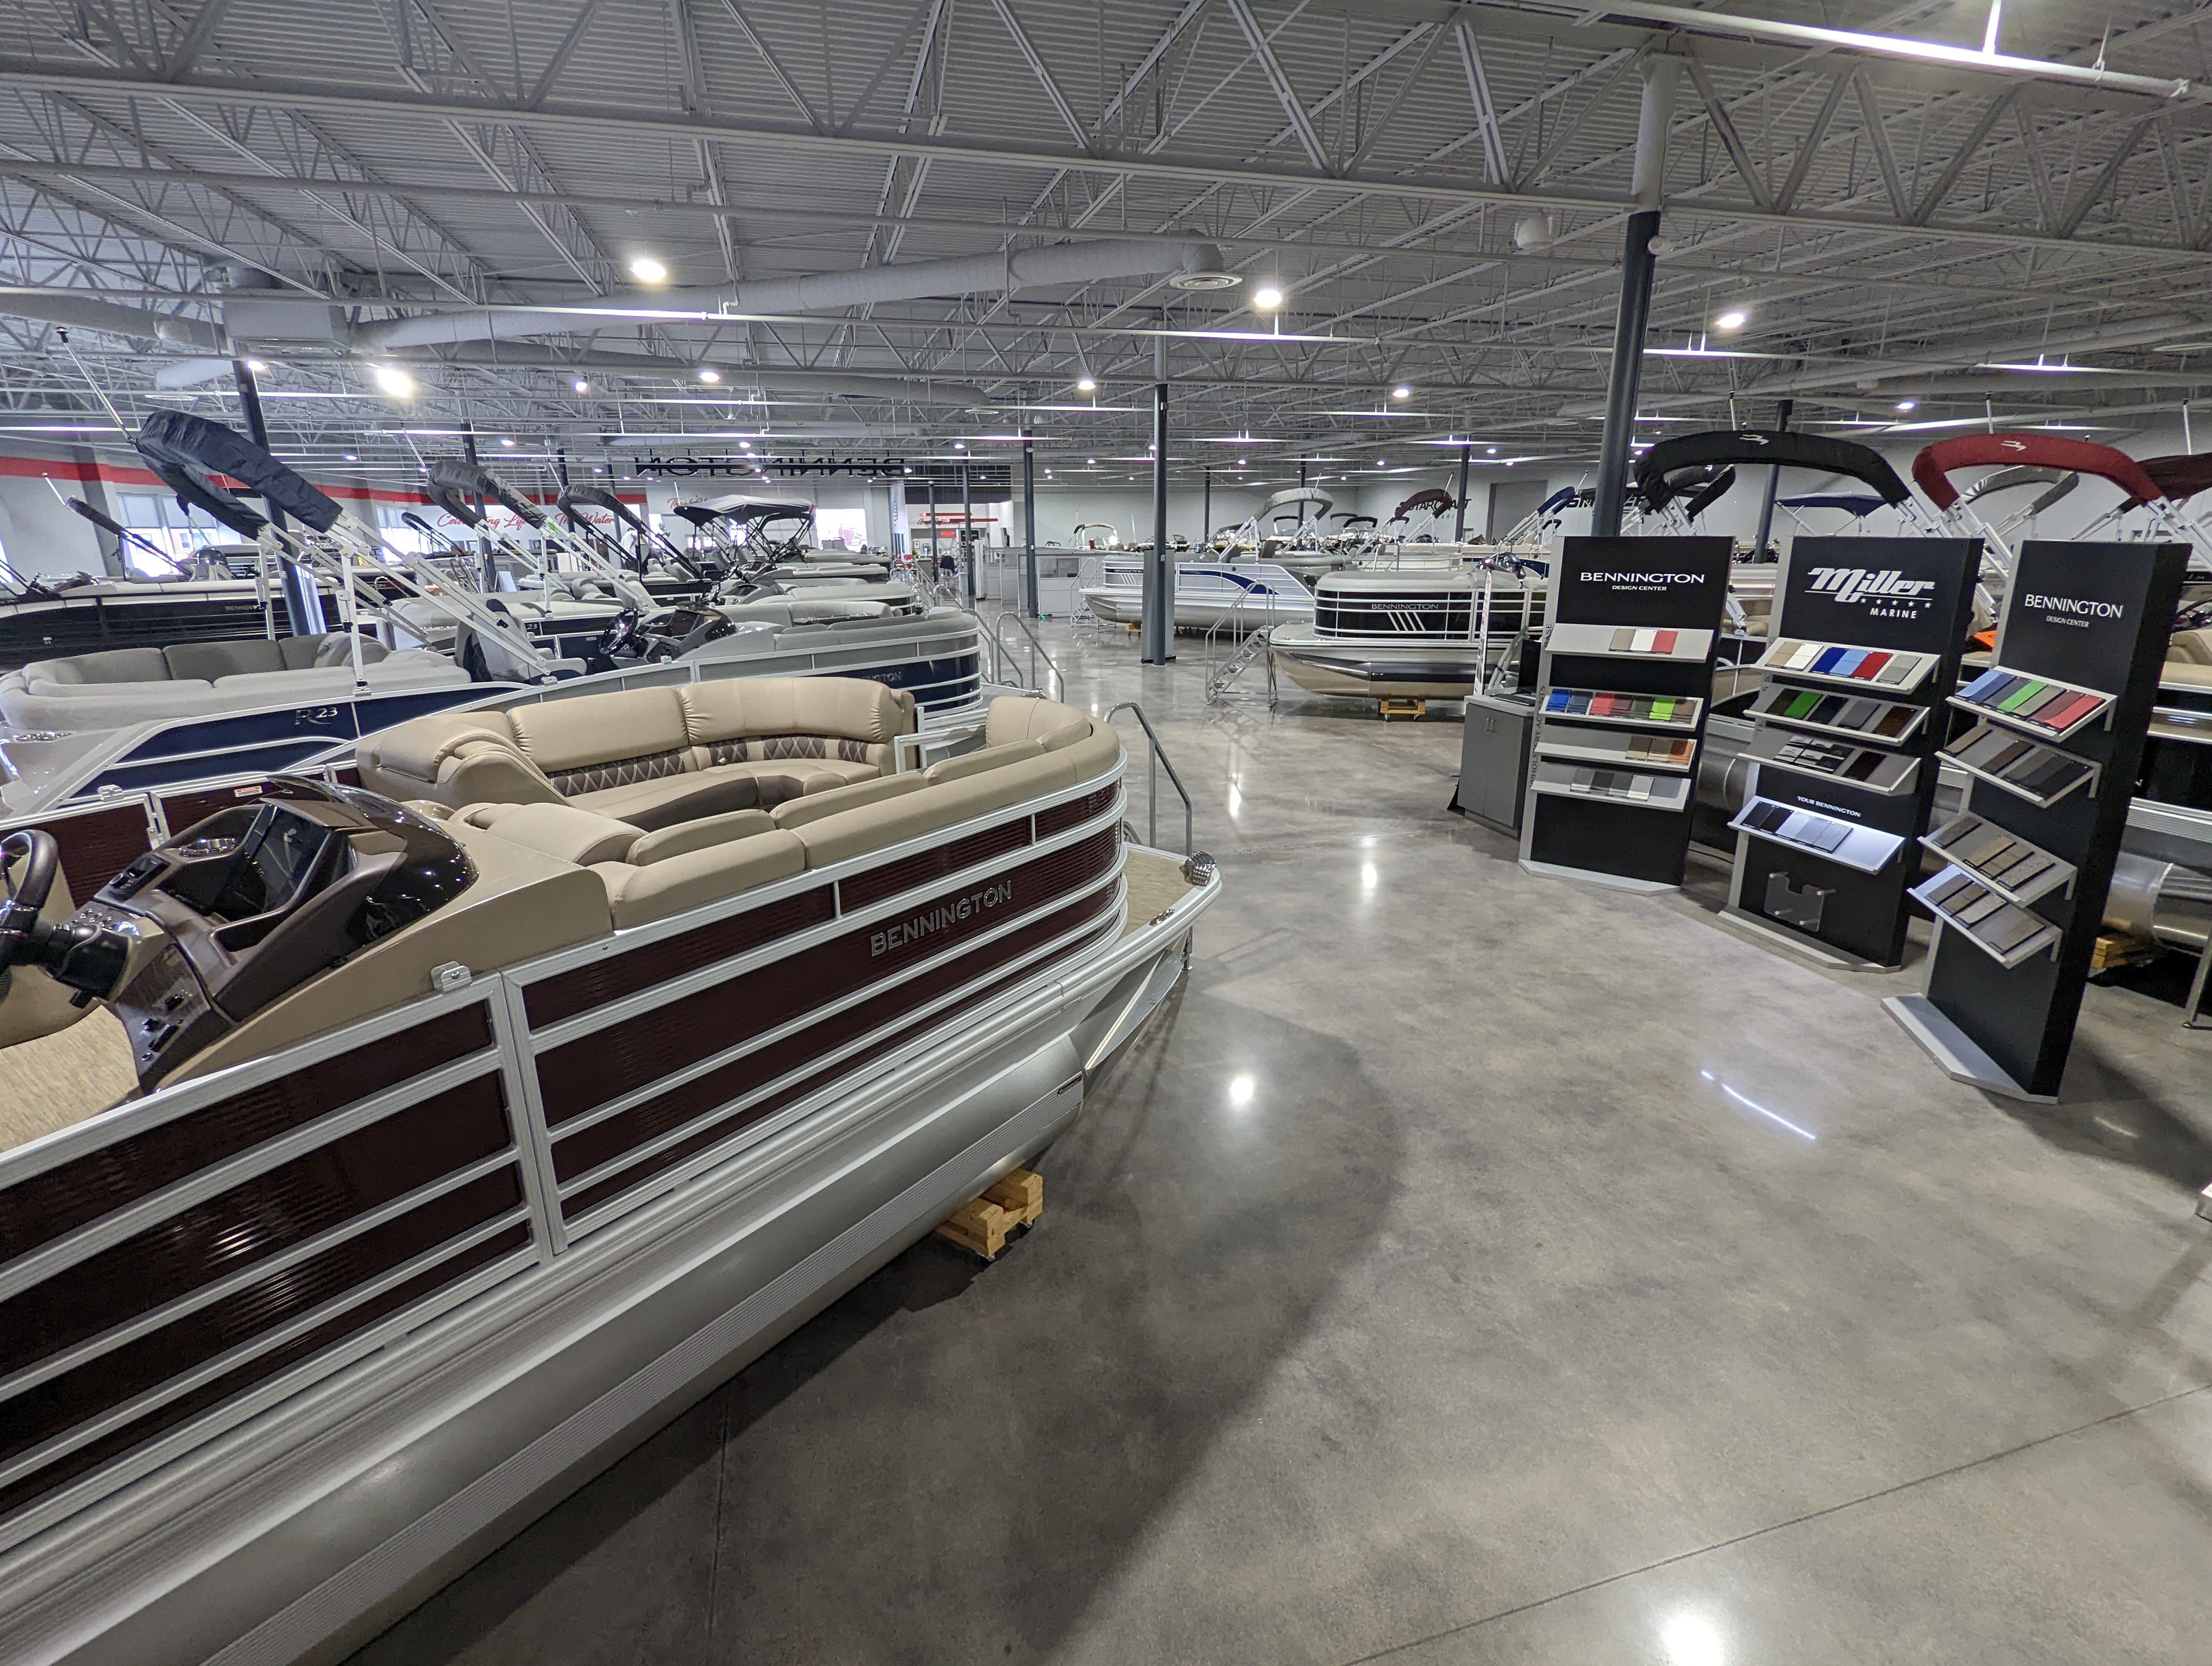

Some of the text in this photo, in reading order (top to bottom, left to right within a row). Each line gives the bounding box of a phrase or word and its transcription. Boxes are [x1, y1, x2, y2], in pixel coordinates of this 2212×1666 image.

[1580, 572, 1705, 584] BENNINGTON
[1808, 567, 1935, 603] Miller
[1870, 607, 1918, 619] MARINE
[2024, 594, 2124, 618] BENNINGTON
[2046, 615, 2089, 627] DESIGN CENTER
[1797, 796, 1861, 817] YOUR BENNINGTON
[870, 880, 1012, 957] BENNINGTON
